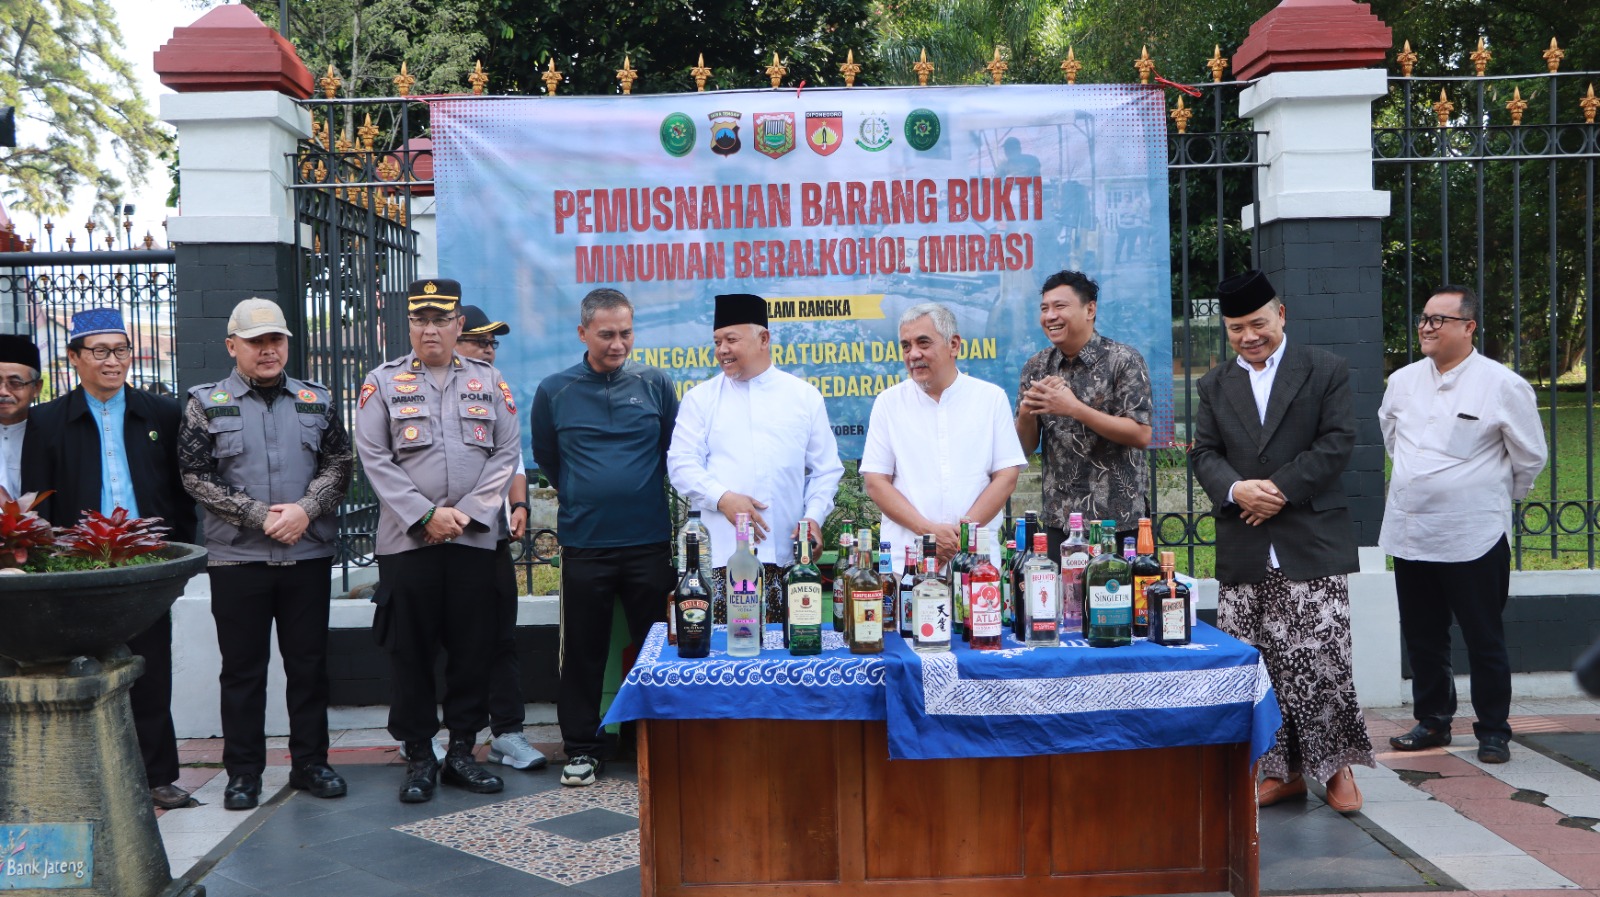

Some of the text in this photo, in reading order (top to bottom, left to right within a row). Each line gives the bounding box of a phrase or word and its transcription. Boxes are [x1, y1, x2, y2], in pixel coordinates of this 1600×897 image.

[553, 176, 1043, 234] PEMUSNAHAN BARANG BUKTI
[575, 233, 1034, 284] MINUMAN BERALKOHOL (MIRAS)
[768, 299, 851, 318] LAM RANGKA
[771, 341, 865, 365] RATURAN
[391, 395, 426, 404] DARIANTO
[460, 393, 493, 402] POLRI
[830, 424, 865, 436] OBER
[790, 585, 821, 595] JAMESON
[729, 594, 759, 604] ICELAND
[7, 858, 85, 879] Bank Jateng
